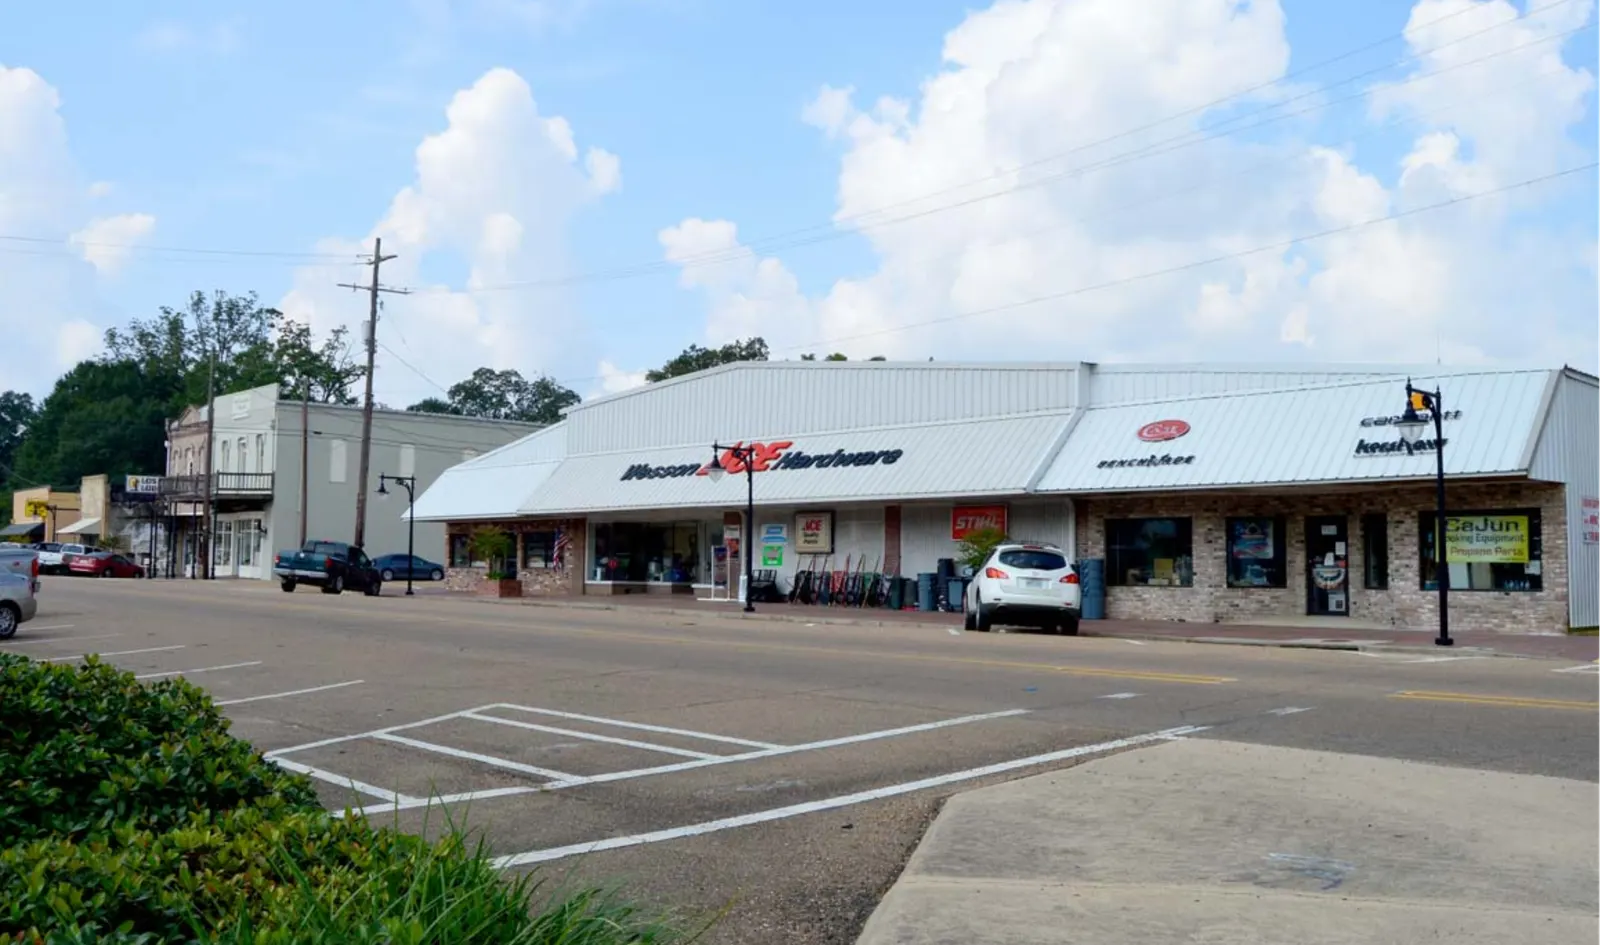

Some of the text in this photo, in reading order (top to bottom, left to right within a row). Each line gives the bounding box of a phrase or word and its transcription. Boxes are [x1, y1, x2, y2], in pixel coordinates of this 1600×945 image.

[770, 448, 903, 471] Hardware
[803, 519, 824, 532] ACE
[956, 515, 999, 530] STIHL
